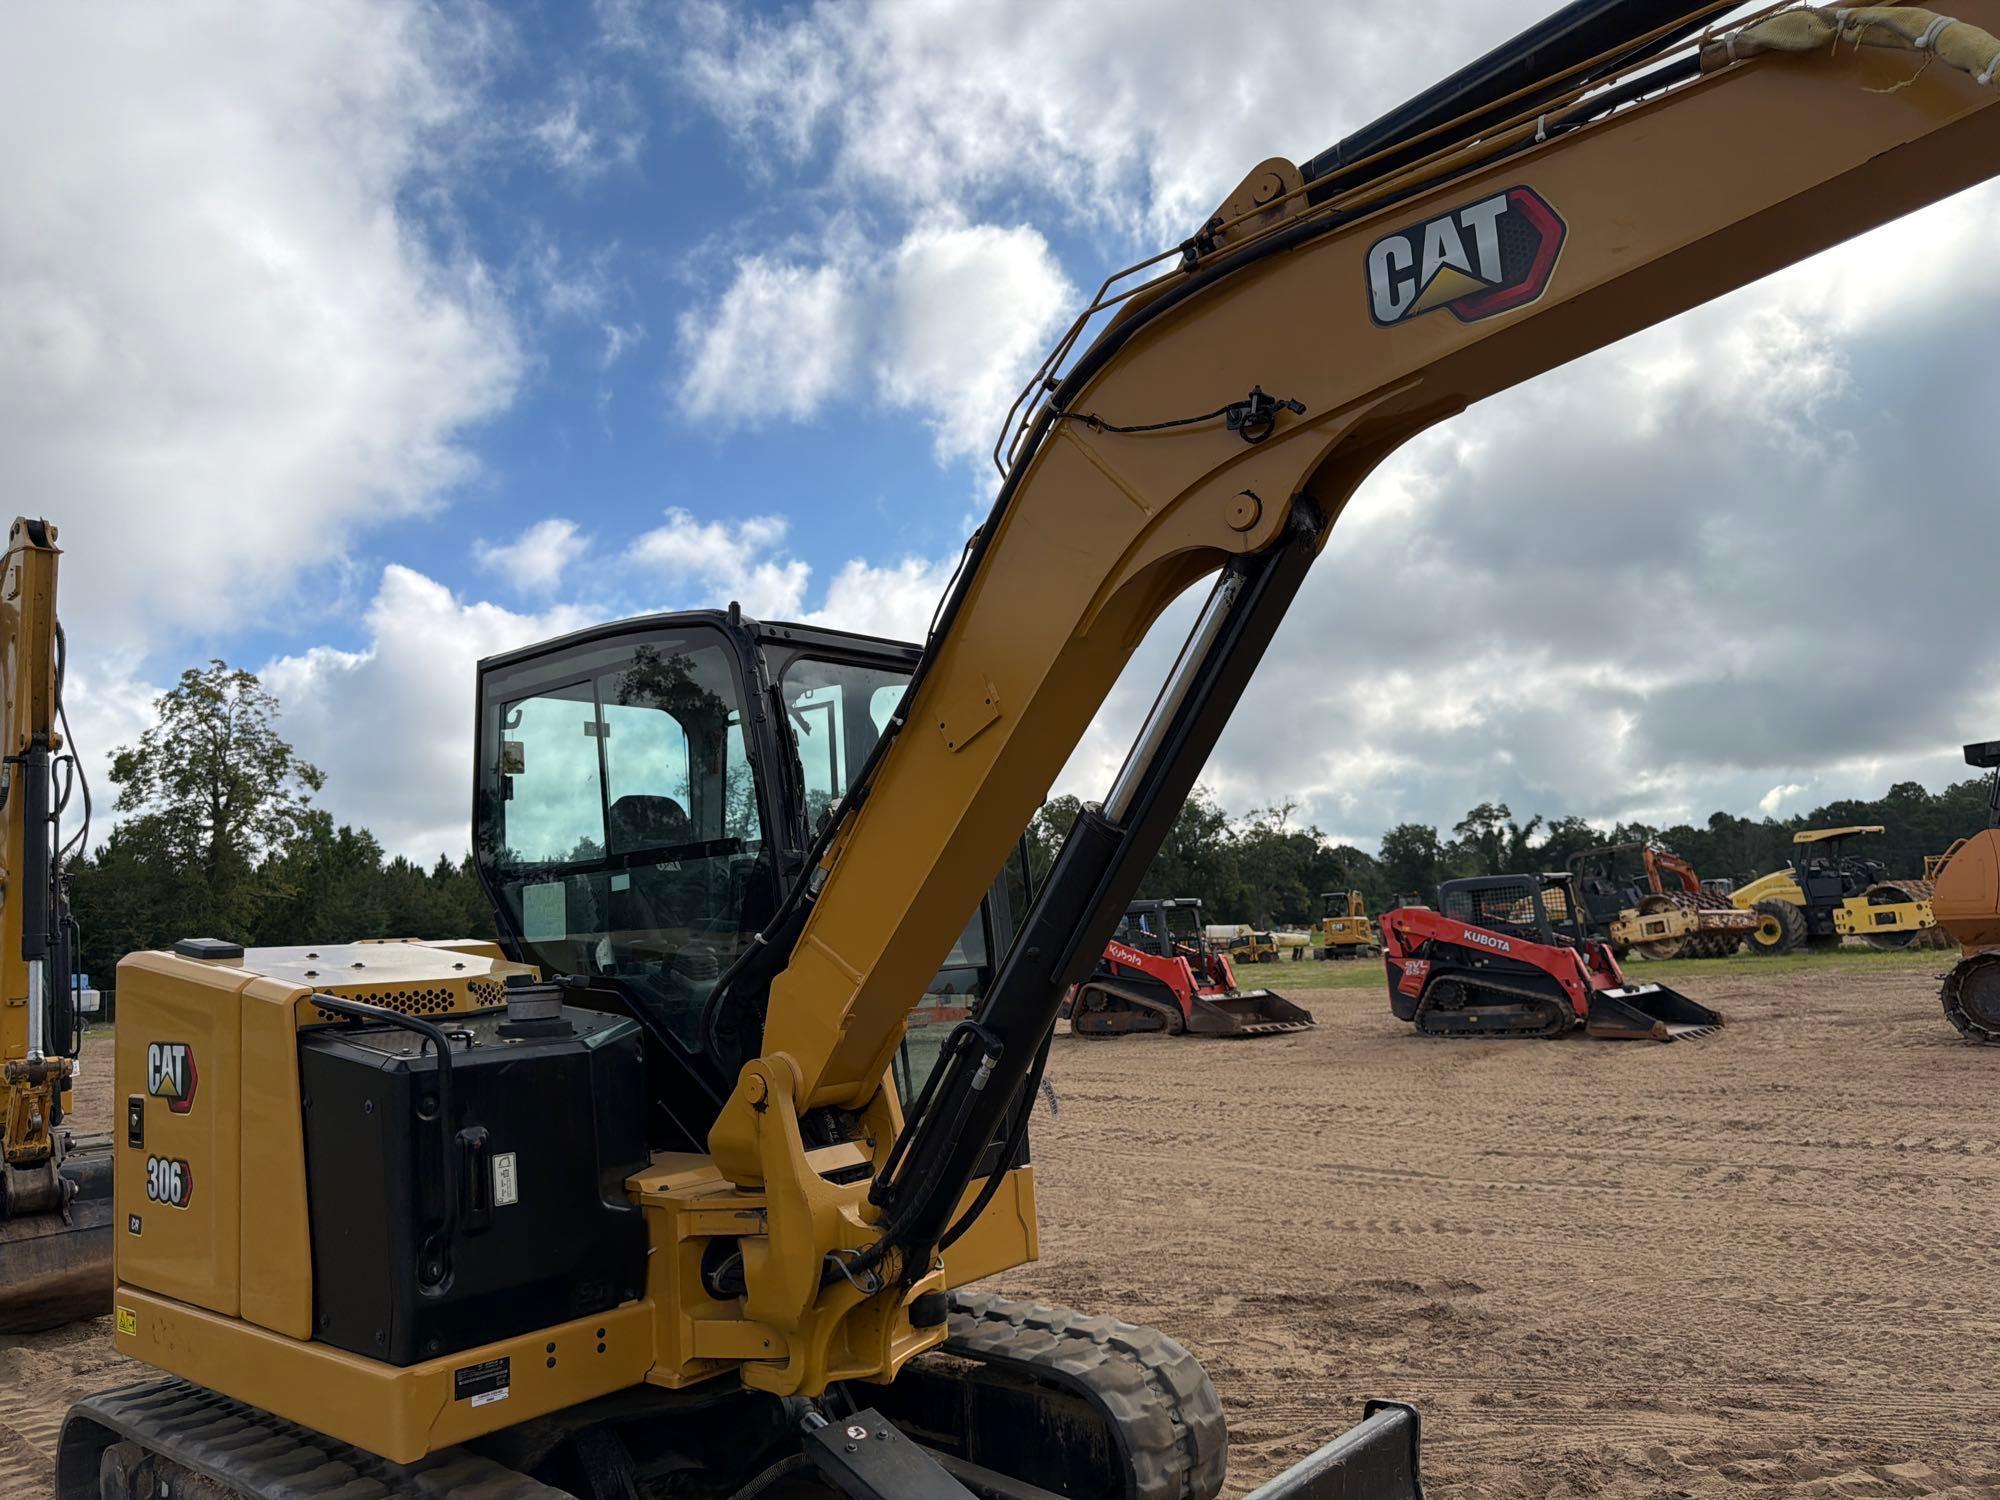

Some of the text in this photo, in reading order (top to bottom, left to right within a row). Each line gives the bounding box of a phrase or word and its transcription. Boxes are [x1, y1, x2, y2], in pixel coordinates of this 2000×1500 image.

[1369, 194, 1508, 322] CAT
[1109, 945, 1142, 966] Kubota
[1463, 930, 1510, 952] KUBOTA
[149, 1044, 185, 1096] CAT
[148, 1157, 182, 1203] 306
